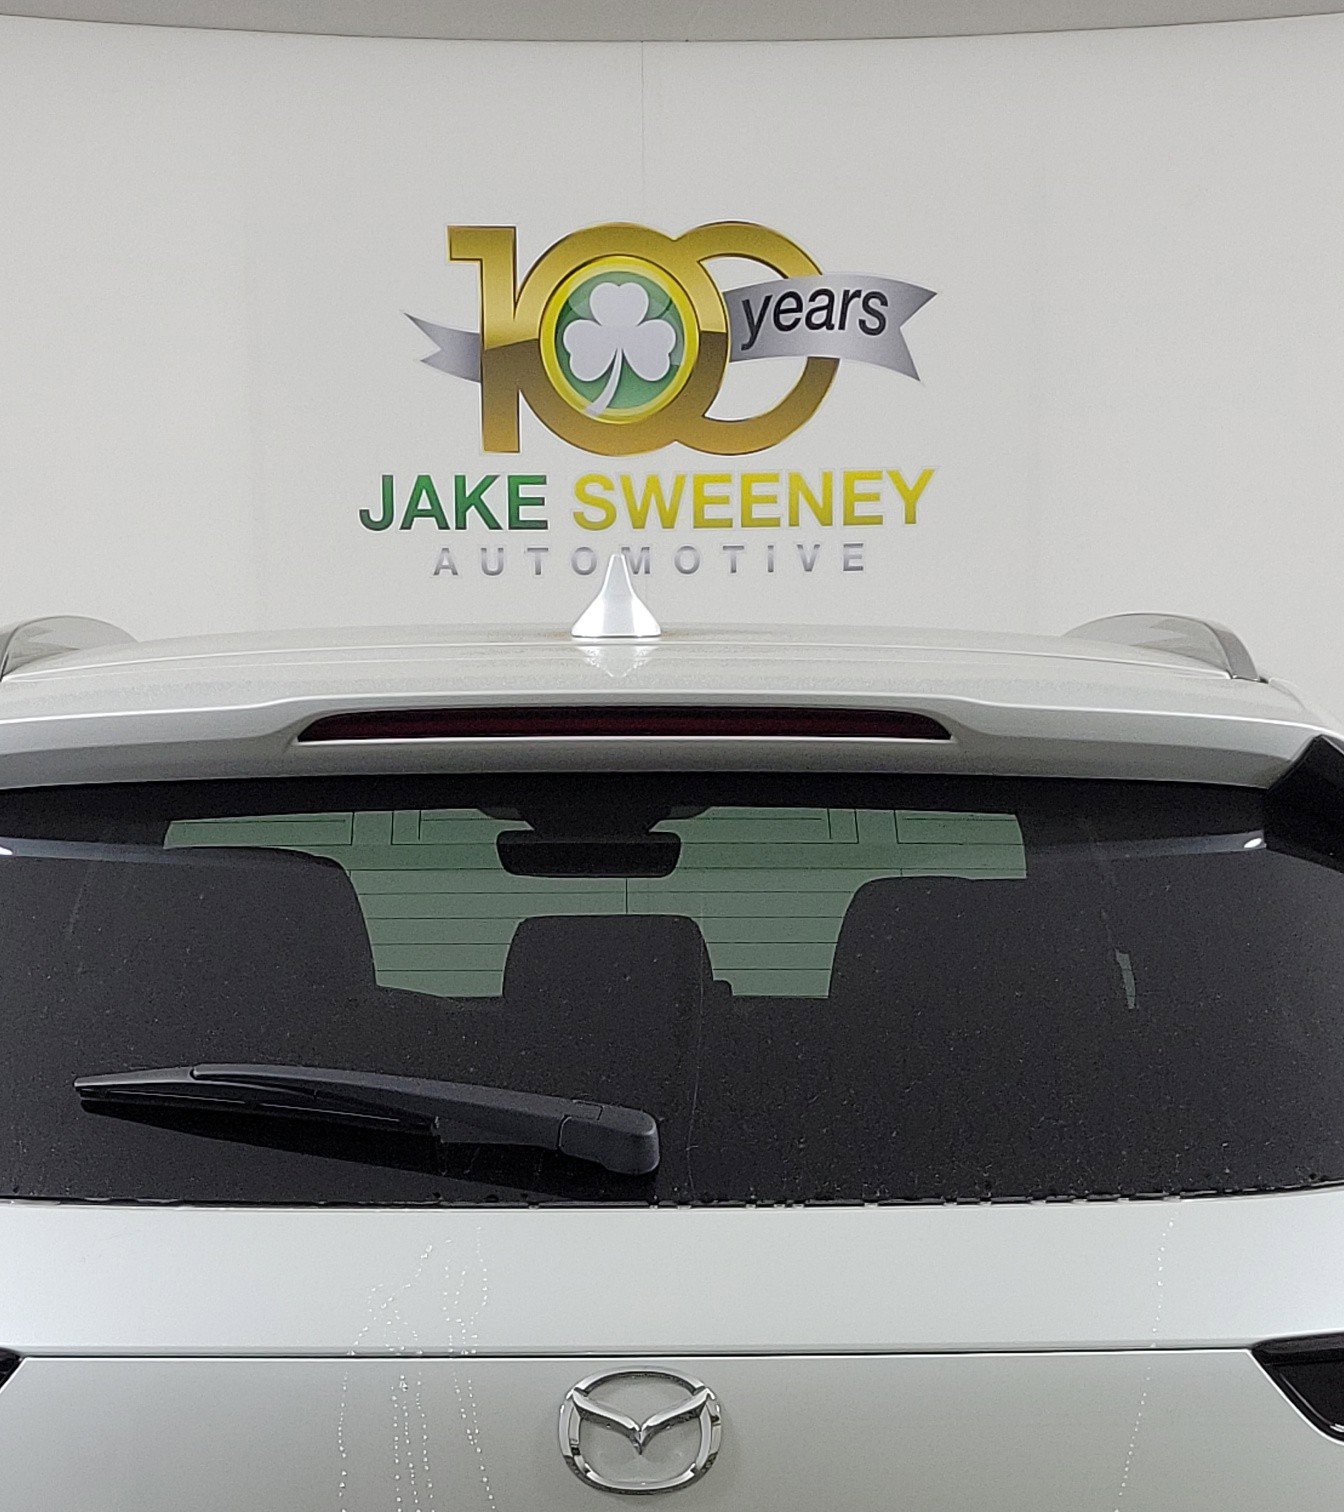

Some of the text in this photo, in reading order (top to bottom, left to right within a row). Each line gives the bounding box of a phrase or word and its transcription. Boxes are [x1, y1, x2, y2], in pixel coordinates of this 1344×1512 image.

[446, 221, 889, 456] 100 years
[358, 468, 935, 531] JAKE SWEENEY
[433, 543, 866, 577] AUTOMOTIVE
